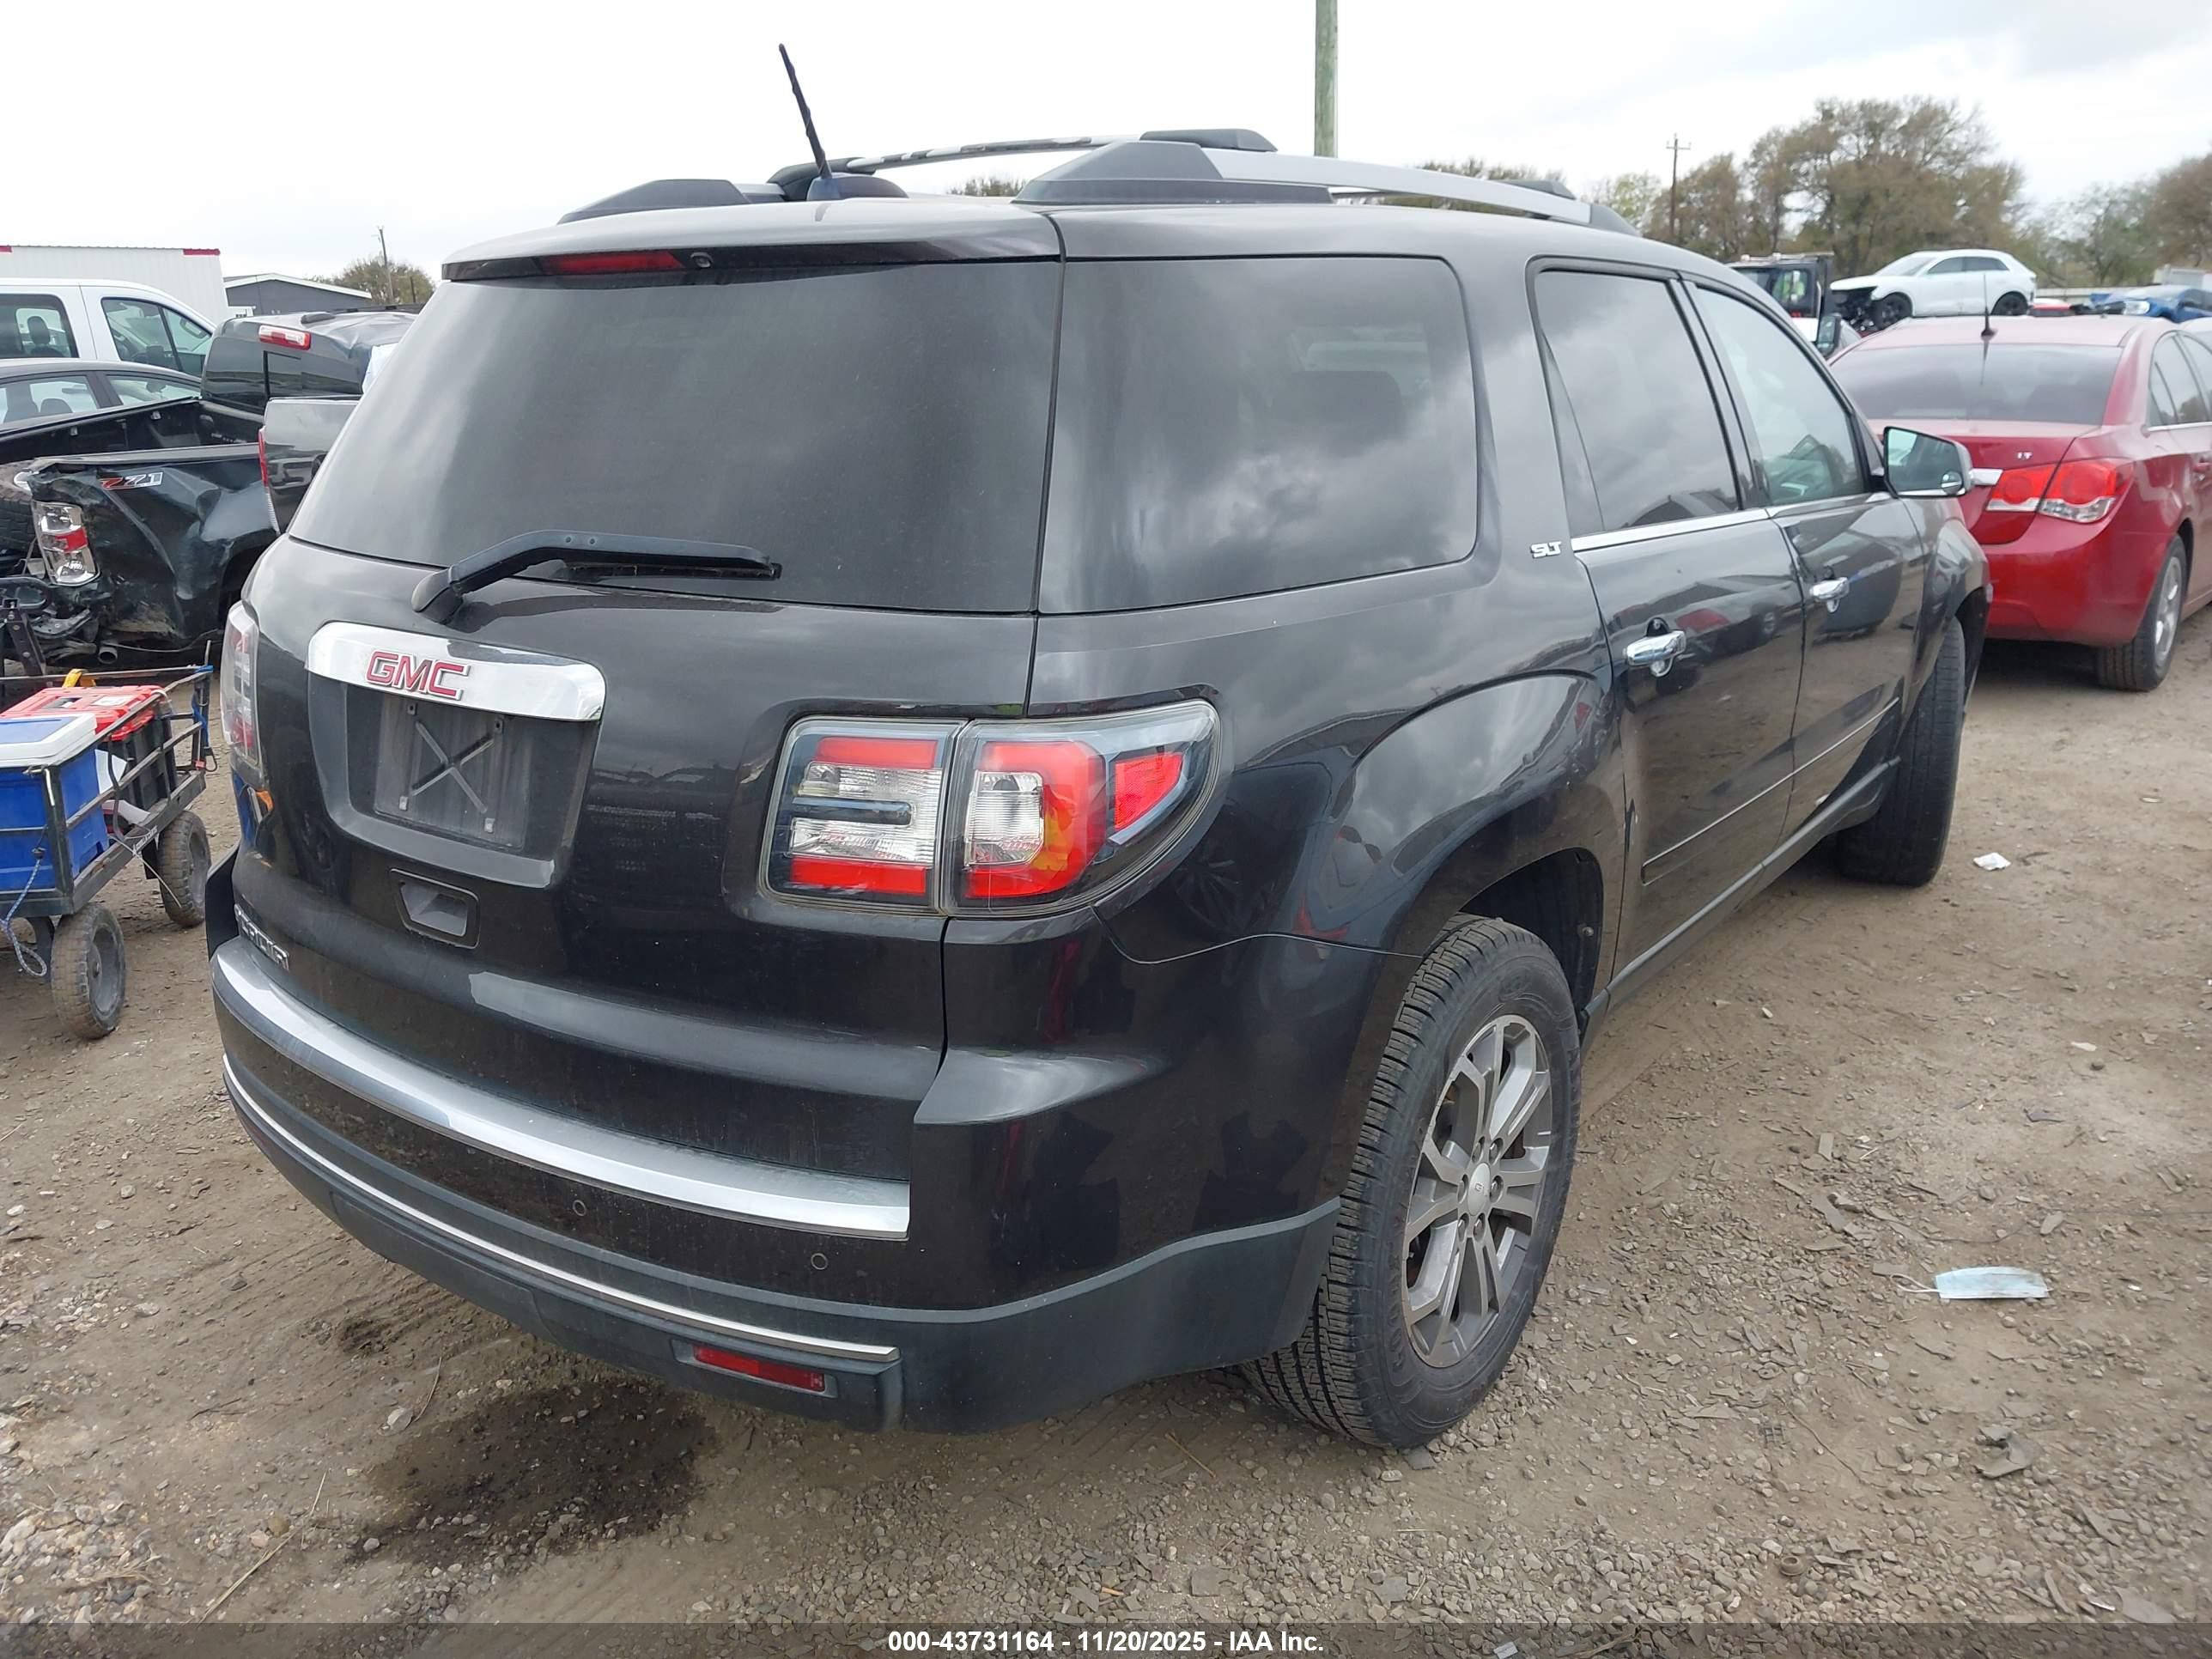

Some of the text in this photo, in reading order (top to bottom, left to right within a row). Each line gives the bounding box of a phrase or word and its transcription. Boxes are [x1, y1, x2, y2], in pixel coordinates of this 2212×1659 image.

[98, 471, 163, 490] Z71
[1530, 541, 1562, 559] SLT
[366, 649, 471, 701] GMC
